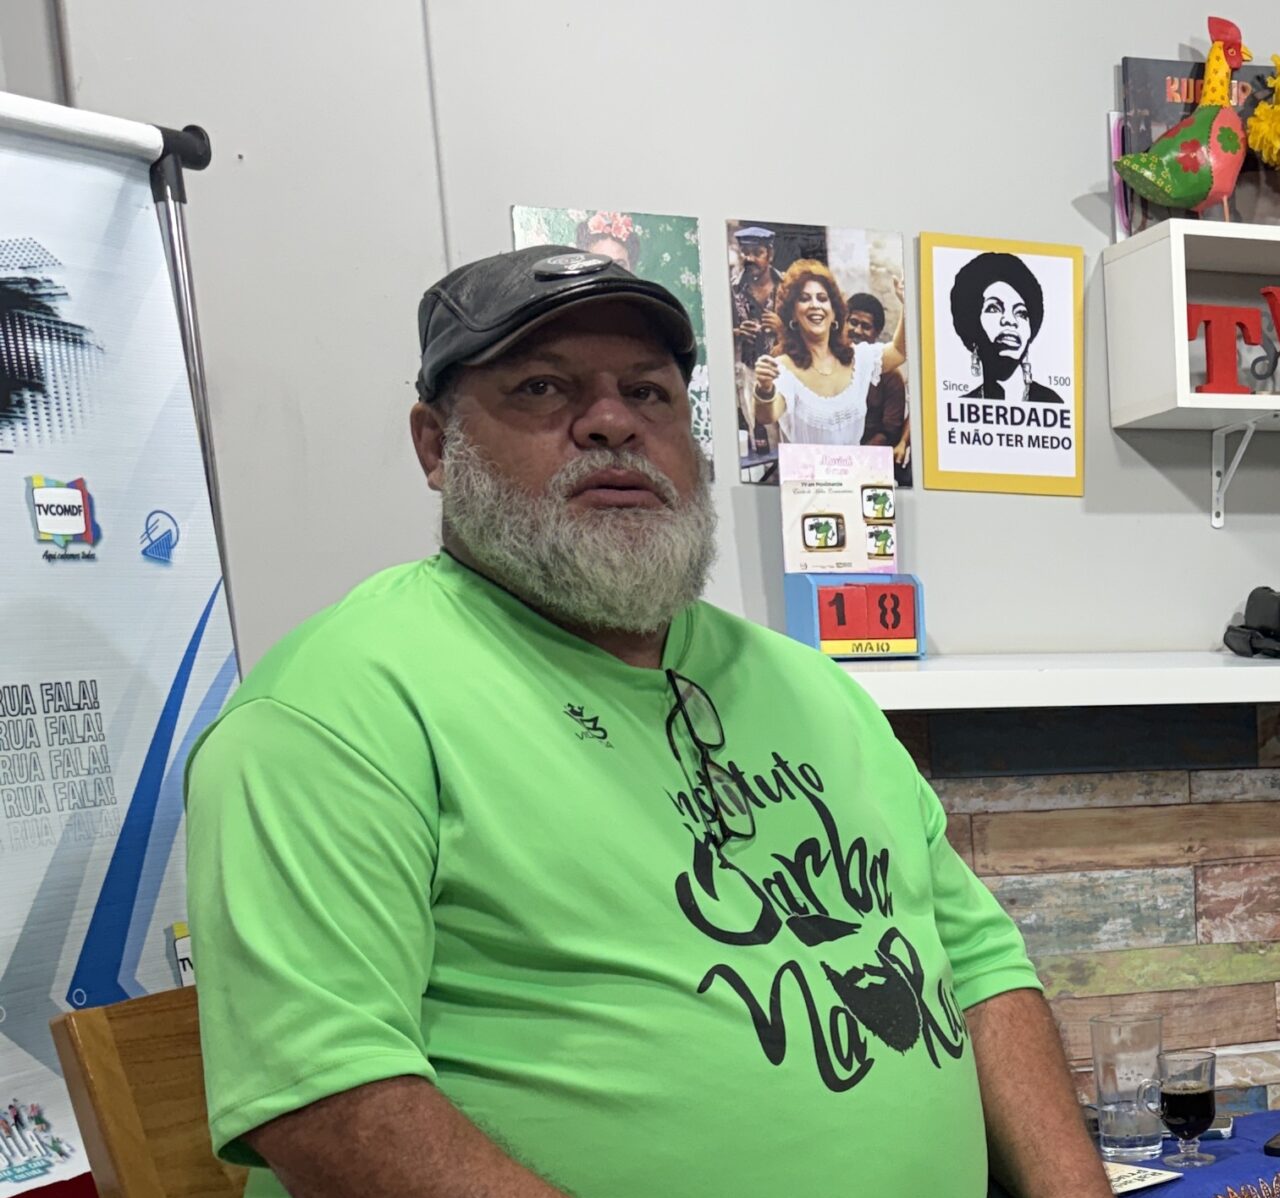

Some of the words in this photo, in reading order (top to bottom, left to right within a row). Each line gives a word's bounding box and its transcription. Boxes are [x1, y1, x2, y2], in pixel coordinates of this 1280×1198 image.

[942, 380, 969, 392] Since
[1048, 376, 1071, 387] 1500
[947, 402, 1071, 429] LIBERDADE
[948, 428, 957, 444] É
[960, 429, 994, 447] NÃO
[996, 433, 1024, 448] TER
[1027, 435, 1072, 450] MEDO
[36, 504, 82, 516] TVCOMDF
[851, 642, 890, 653] MAIO
[40, 680, 100, 714] FALA!
[44, 713, 105, 747] FALA!
[0, 752, 45, 785] RUA
[49, 745, 111, 779] FALA!
[1, 785, 51, 818] RUA
[53, 777, 117, 812] FALA!
[7, 818, 57, 849] RUA
[59, 808, 121, 843] FALA!
